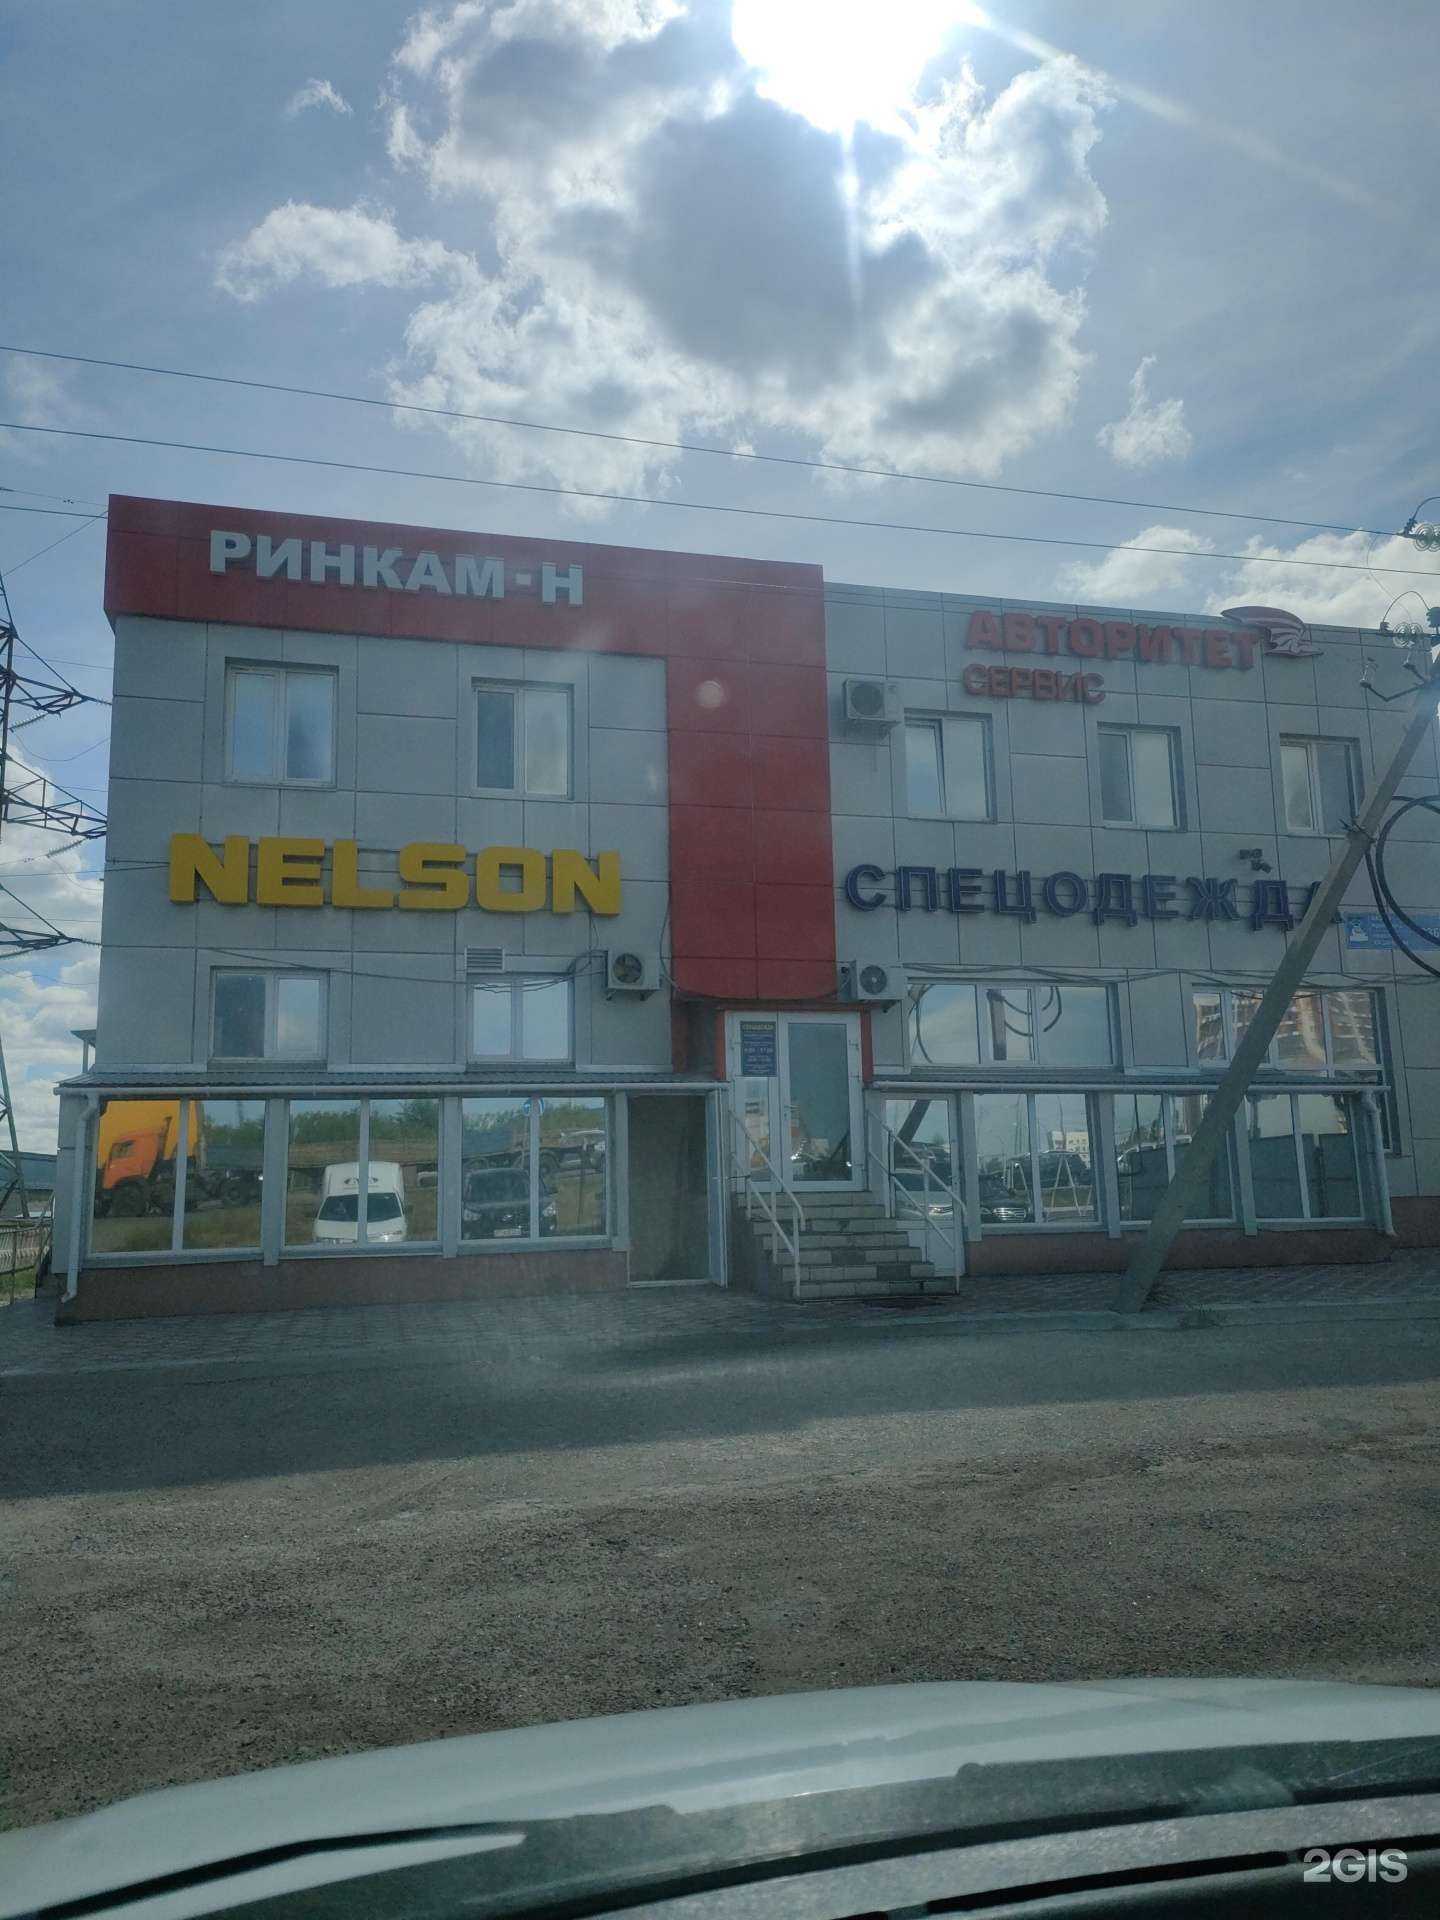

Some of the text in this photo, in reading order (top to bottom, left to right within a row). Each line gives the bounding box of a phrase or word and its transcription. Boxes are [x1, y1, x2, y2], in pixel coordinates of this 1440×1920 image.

[209, 529, 584, 606] РИНКАМ-Н
[964, 609, 1259, 669] АВТОРИТЕТ
[962, 663, 1106, 704] СЕРВИС
[168, 832, 622, 917] NELSON
